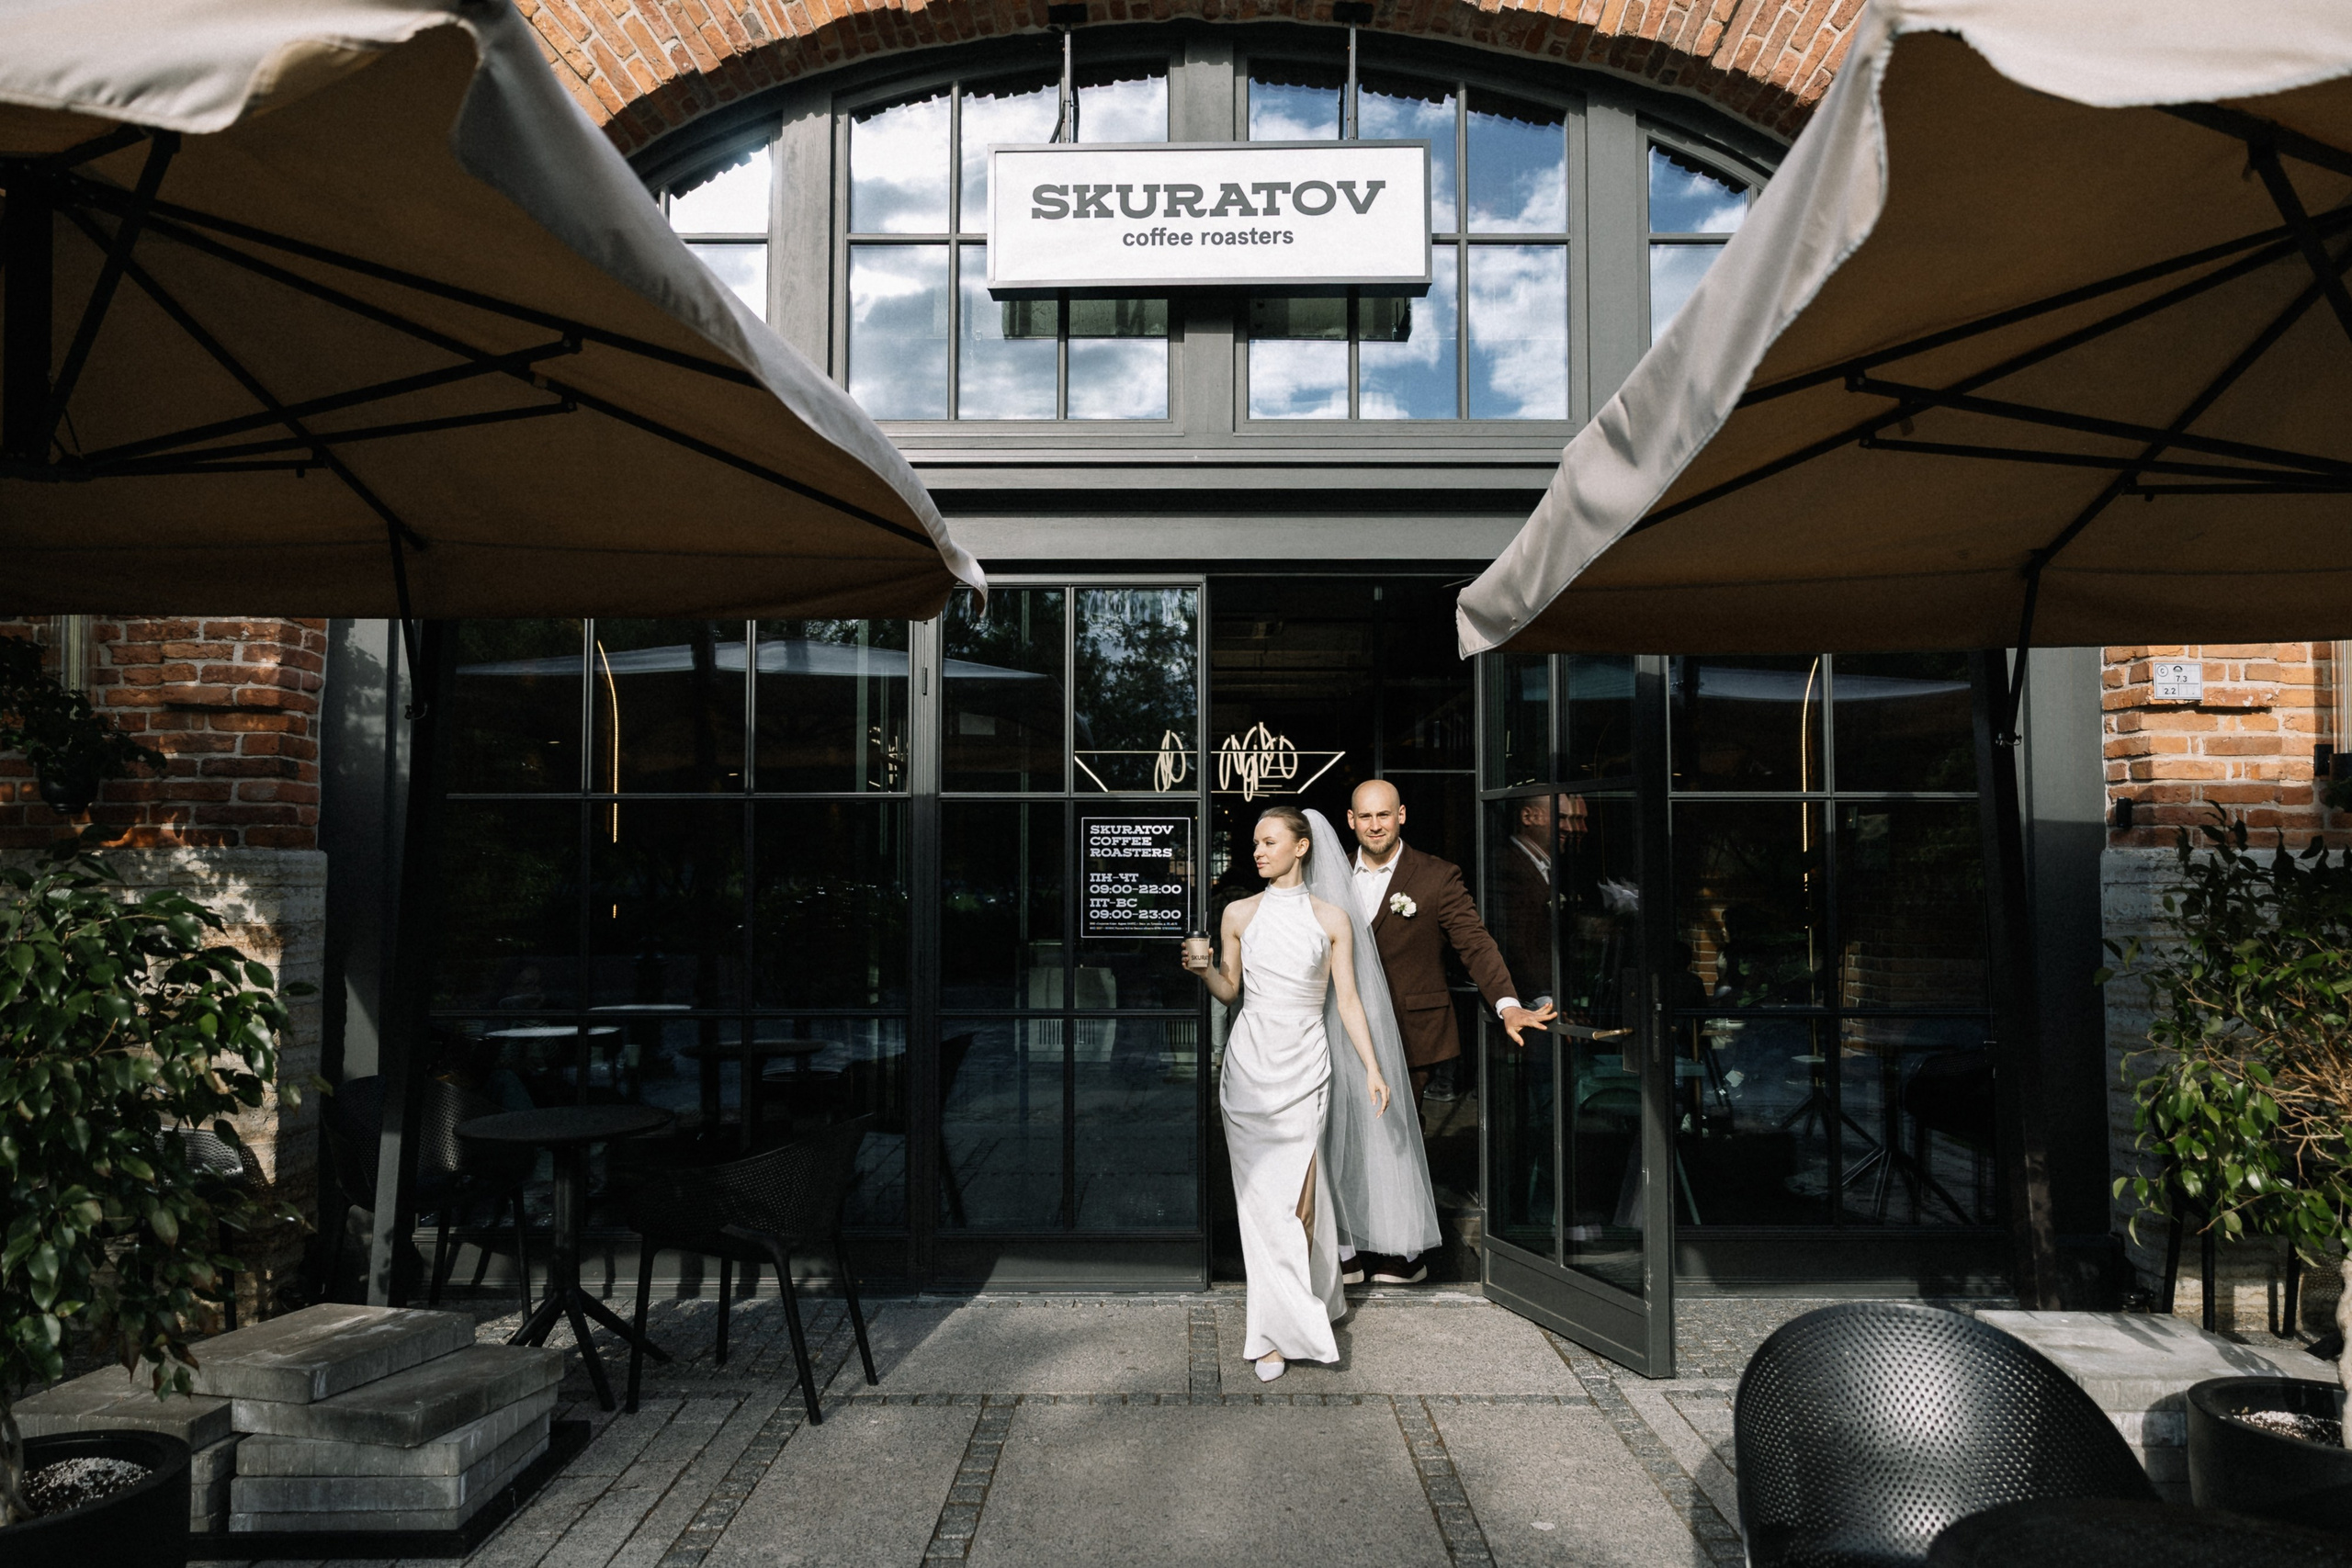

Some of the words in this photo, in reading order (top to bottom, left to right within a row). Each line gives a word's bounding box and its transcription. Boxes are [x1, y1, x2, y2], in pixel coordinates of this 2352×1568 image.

[1032, 180, 1385, 220] SKURATOV
[1122, 227, 1193, 247] coffee
[1201, 227, 1294, 246] roasters
[1090, 825, 1174, 835] SKURATOV
[1090, 837, 1152, 846] COFFEE
[1090, 848, 1173, 857] ROASTERS
[1090, 873, 1139, 882] ПН-ЧТ
[1090, 885, 1182, 894] 09:00-22:00
[1090, 898, 1137, 908] ПТ-ВС
[1090, 909, 1182, 919] 09:00-23:00
